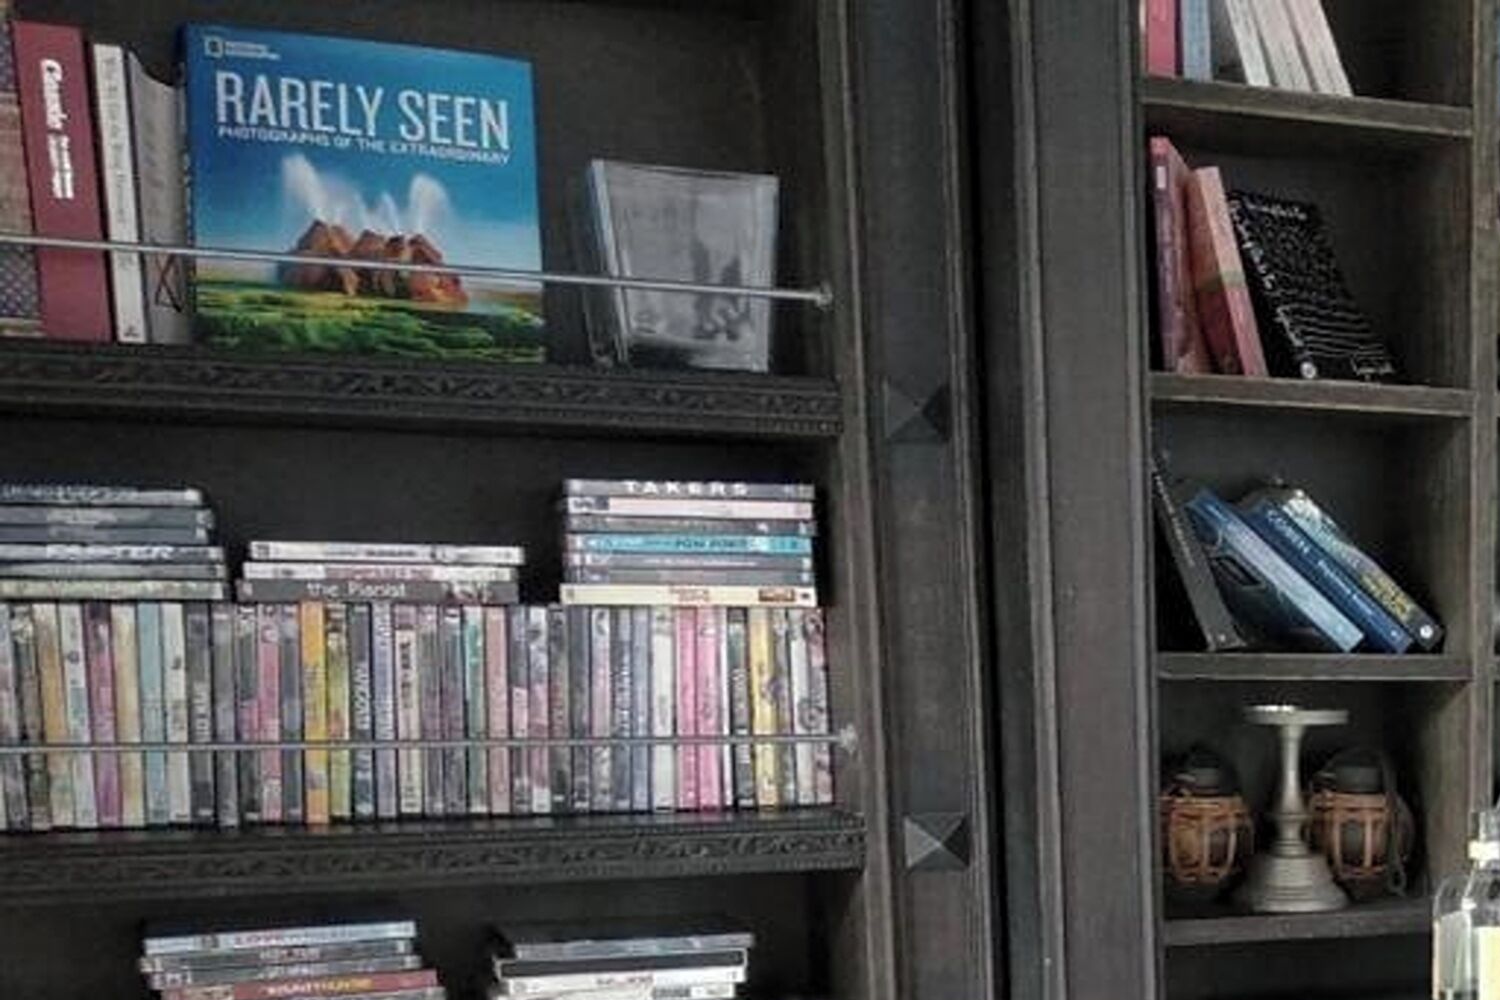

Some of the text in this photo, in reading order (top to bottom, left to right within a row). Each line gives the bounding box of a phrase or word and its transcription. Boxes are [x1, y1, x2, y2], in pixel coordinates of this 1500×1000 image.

[215, 71, 511, 151] RARELY SEEN
[218, 126, 511, 166] PHOTOGRAPHS OF THE EXTRAORDINARY
[622, 481, 750, 496] TAKERS
[307, 581, 408, 599] the Pianist
